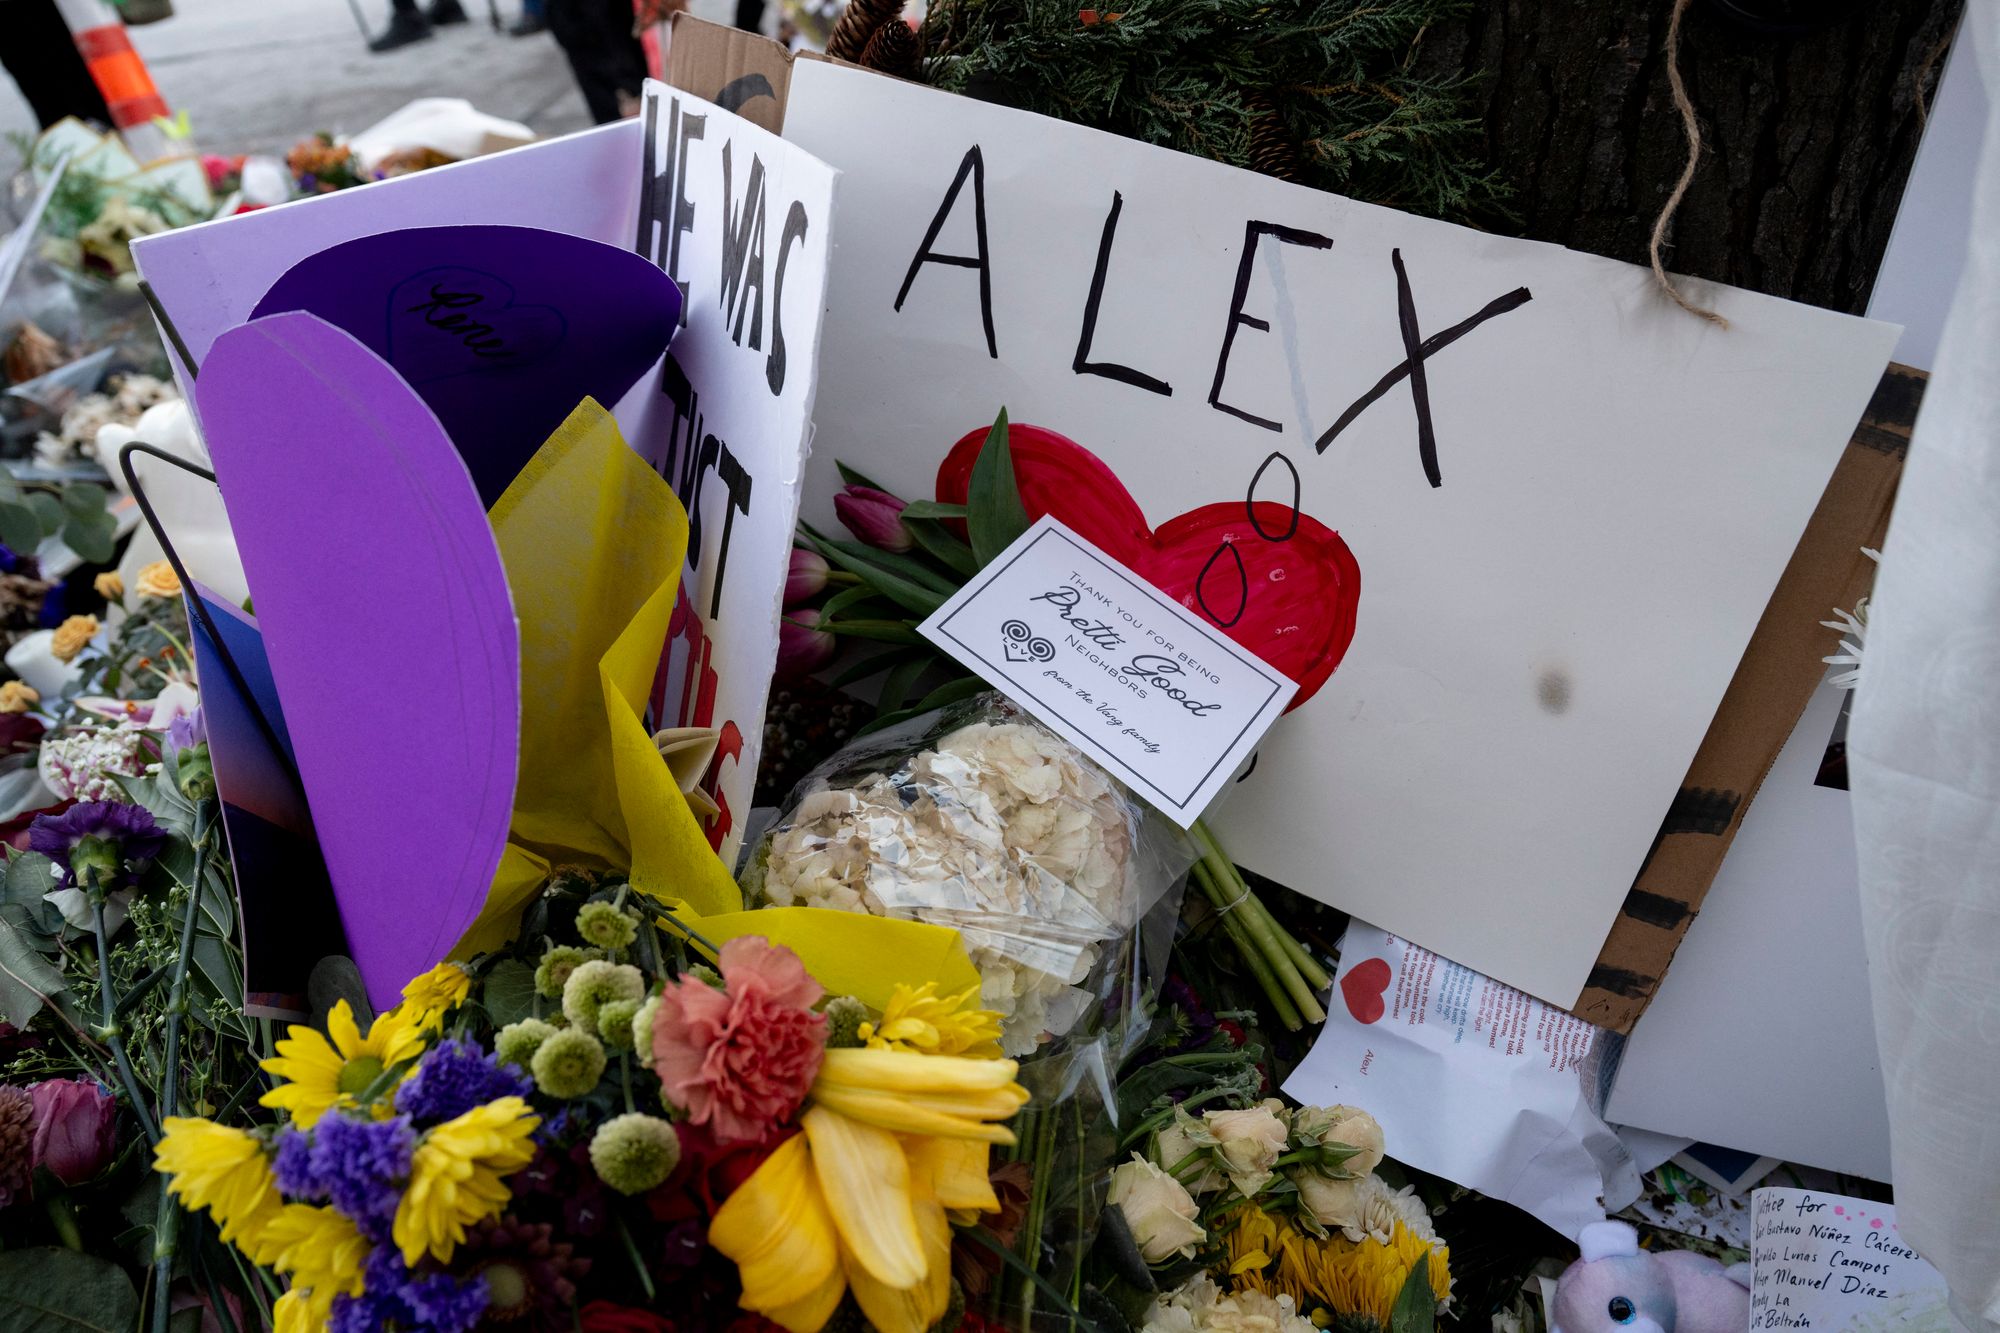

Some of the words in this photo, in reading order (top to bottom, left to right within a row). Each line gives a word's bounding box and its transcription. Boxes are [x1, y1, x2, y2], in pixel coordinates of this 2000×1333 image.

[636, 93, 707, 328] HE
[720, 138, 808, 396] WAS
[894, 144, 1533, 488] ALEX
[1069, 571, 1113, 607] THANK
[1116, 606, 1143, 629] YOU
[1146, 629, 1175, 652] FOR
[1177, 652, 1221, 685] BEING
[1002, 637, 1036, 662] LOVE
[1029, 585, 1126, 651] Pretti
[1121, 654, 1222, 717] Good
[1064, 634, 1148, 699] NEIGHBORS
[1042, 670, 1073, 690] from
[1075, 688, 1094, 705] the
[1096, 702, 1123, 726] Vang
[1121, 727, 1161, 754] family
[1359, 1048, 1375, 1077] Alex!
[1796, 1195, 1827, 1216] for
[1809, 1224, 1853, 1244] Núñez
[1829, 1250, 1890, 1275] Campos
[1773, 1268, 1832, 1290] Manuel
[1840, 1275, 1889, 1299] Díaz
[1775, 1293, 1790, 1307] La
[1765, 1309, 1810, 1329] Beltrán
